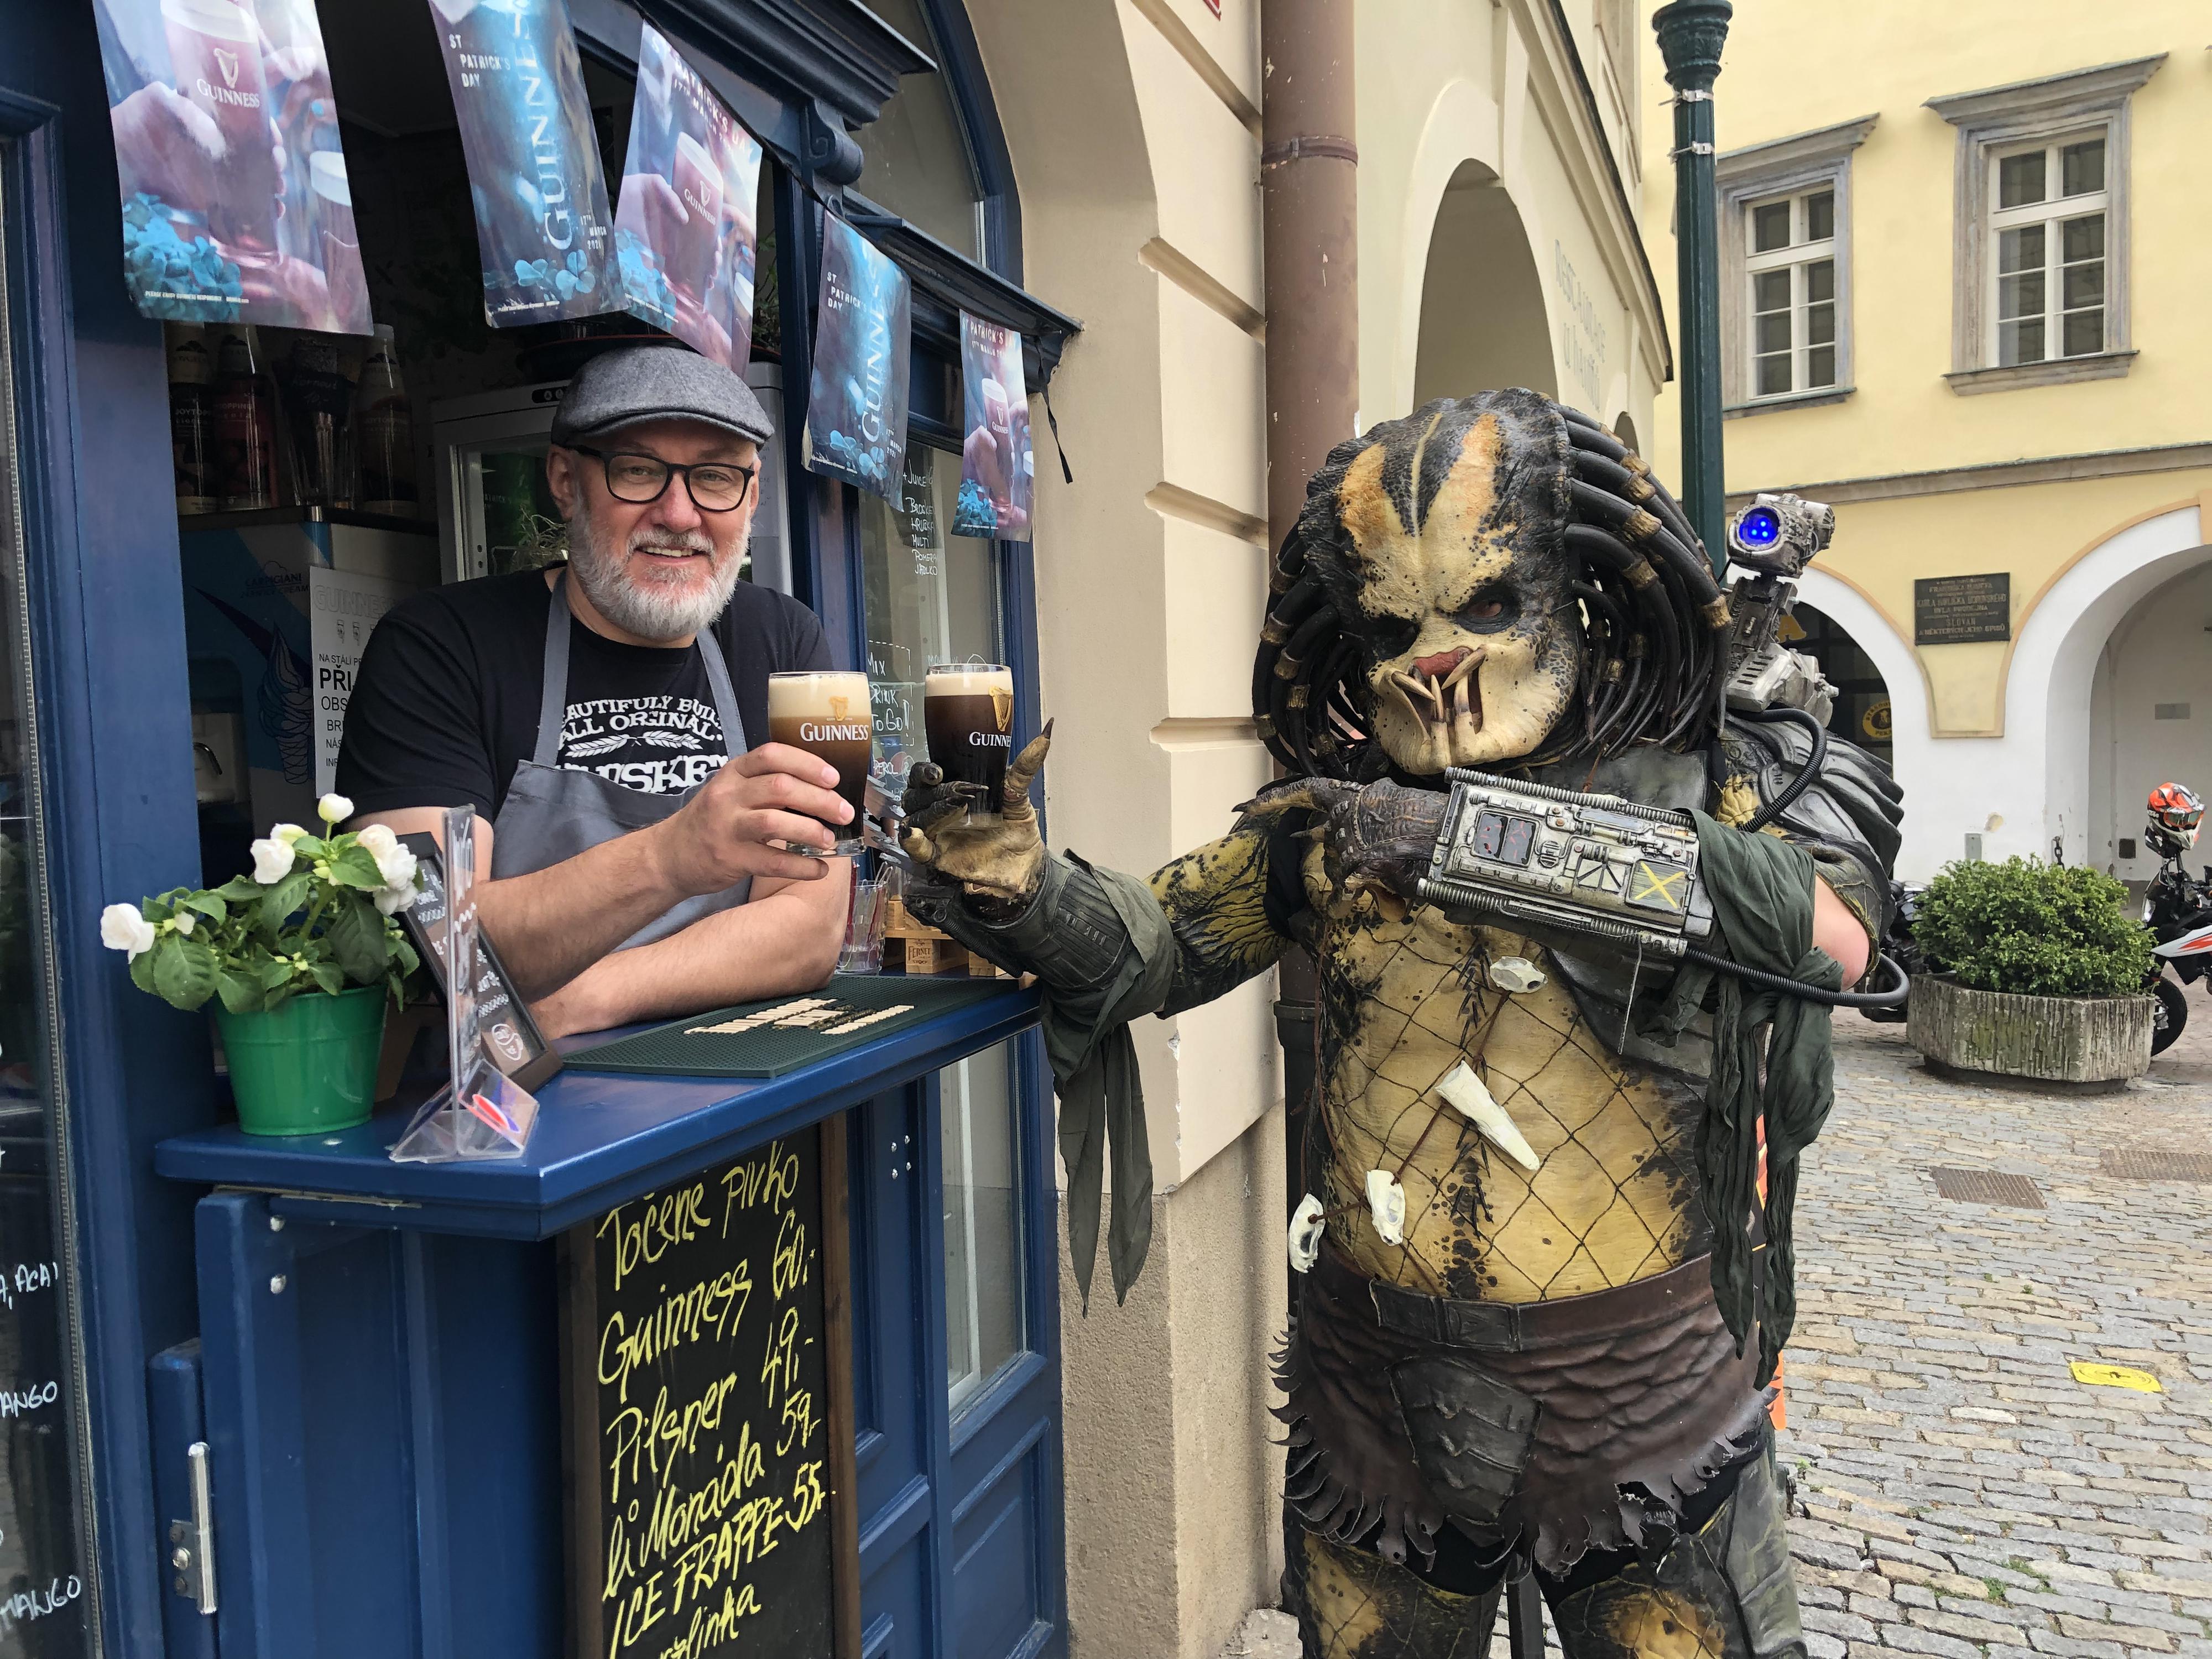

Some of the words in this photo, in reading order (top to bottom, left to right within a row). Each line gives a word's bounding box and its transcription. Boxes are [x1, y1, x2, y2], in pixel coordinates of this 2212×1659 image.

[448, 34, 461, 49] ST
[460, 54, 511, 71] PATRICK'S
[461, 72, 480, 88] DAY
[196, 77, 260, 109] GUINNESS
[684, 188, 716, 226] GUINNESS
[589, 226, 607, 237] MARCH
[587, 239, 602, 249] 2021
[827, 271, 837, 284] ST
[828, 297, 843, 311] DAY
[831, 286, 867, 312] PATRICK'S
[971, 321, 1004, 345] PATRICK'S
[907, 458, 927, 487] JUICE
[319, 653, 330, 662] NA
[320, 664, 352, 692] PŘI
[677, 698, 722, 730] BUIL
[800, 722, 869, 742] GUINNESS
[598, 1258, 753, 1405] Guinness
[606, 1372, 737, 1504] Pilsner
